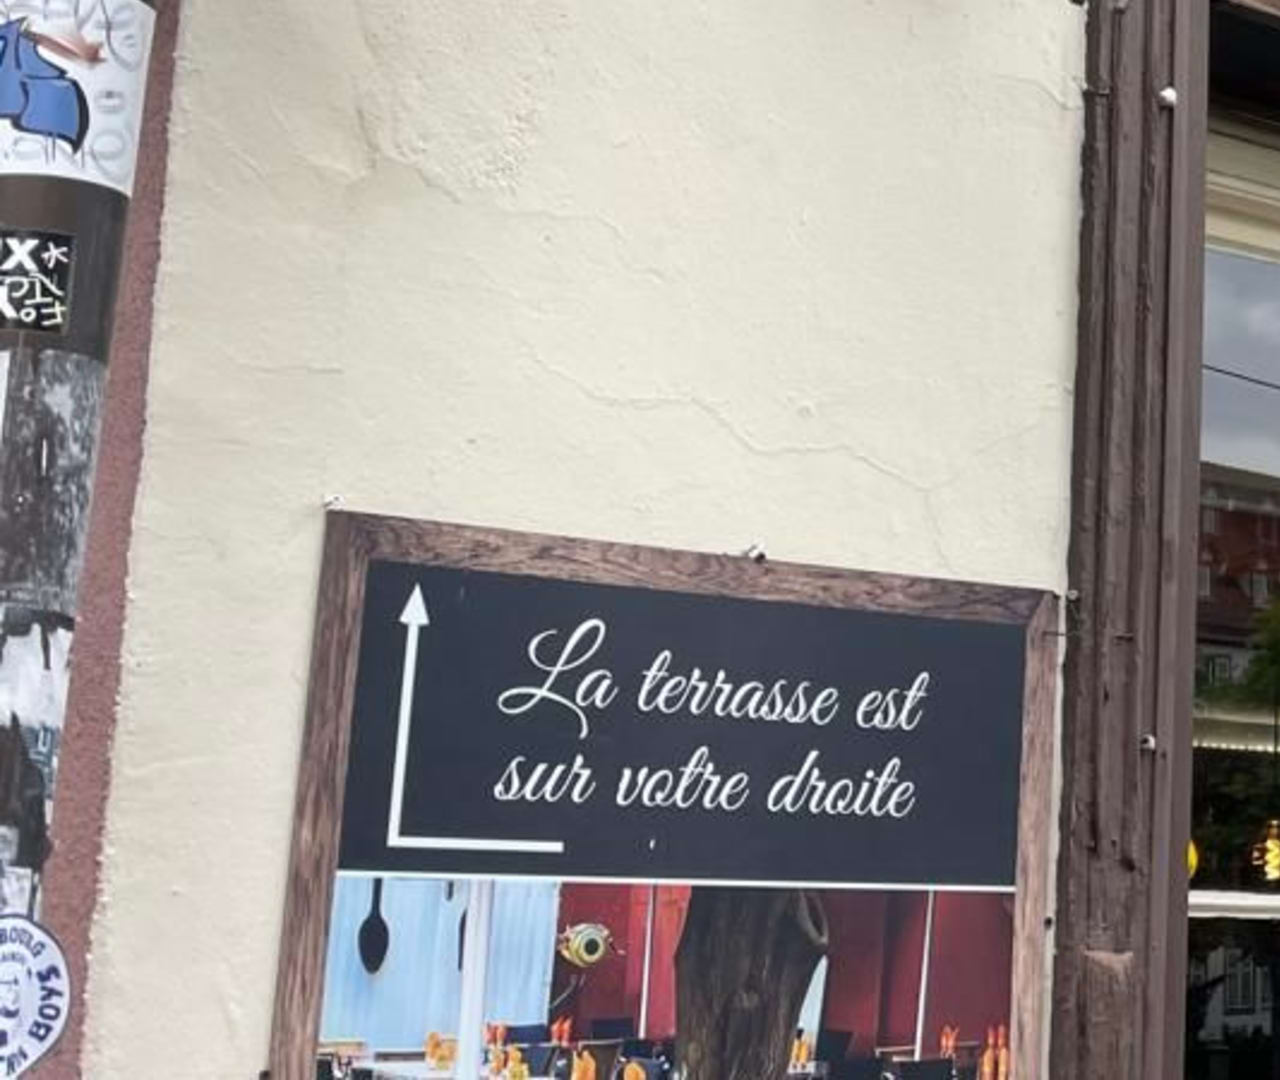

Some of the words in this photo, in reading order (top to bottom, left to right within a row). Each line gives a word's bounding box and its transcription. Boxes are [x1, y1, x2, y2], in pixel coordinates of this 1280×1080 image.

[497, 618, 620, 739] La
[636, 650, 839, 727] terrasse
[855, 671, 931, 732] est
[493, 752, 597, 804] sur
[614, 745, 750, 813] votre
[765, 749, 918, 820] droite
[28, 964, 64, 1042] BOYS
